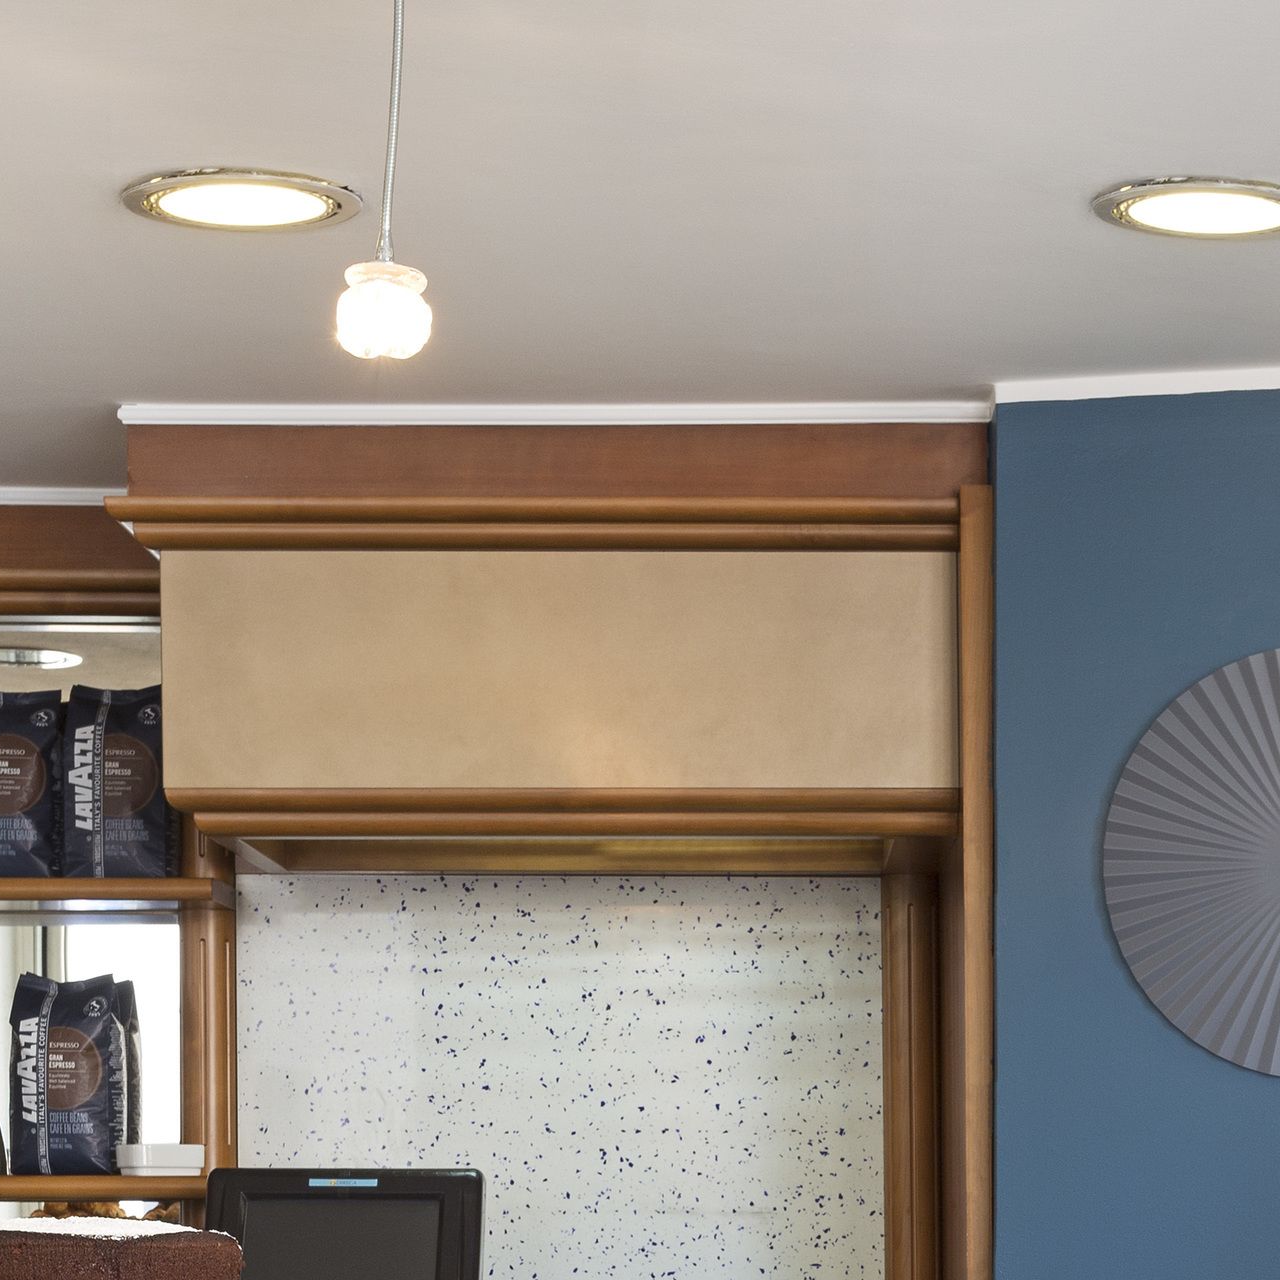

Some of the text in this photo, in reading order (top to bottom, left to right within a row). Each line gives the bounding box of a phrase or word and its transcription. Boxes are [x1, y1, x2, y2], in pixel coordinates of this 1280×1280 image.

[68, 725, 95, 830] LAVAZZA
[38, 1046, 46, 1092] FAVOURITE
[39, 1018, 47, 1046] COFFEE
[17, 1017, 39, 1123] LAVAZZA
